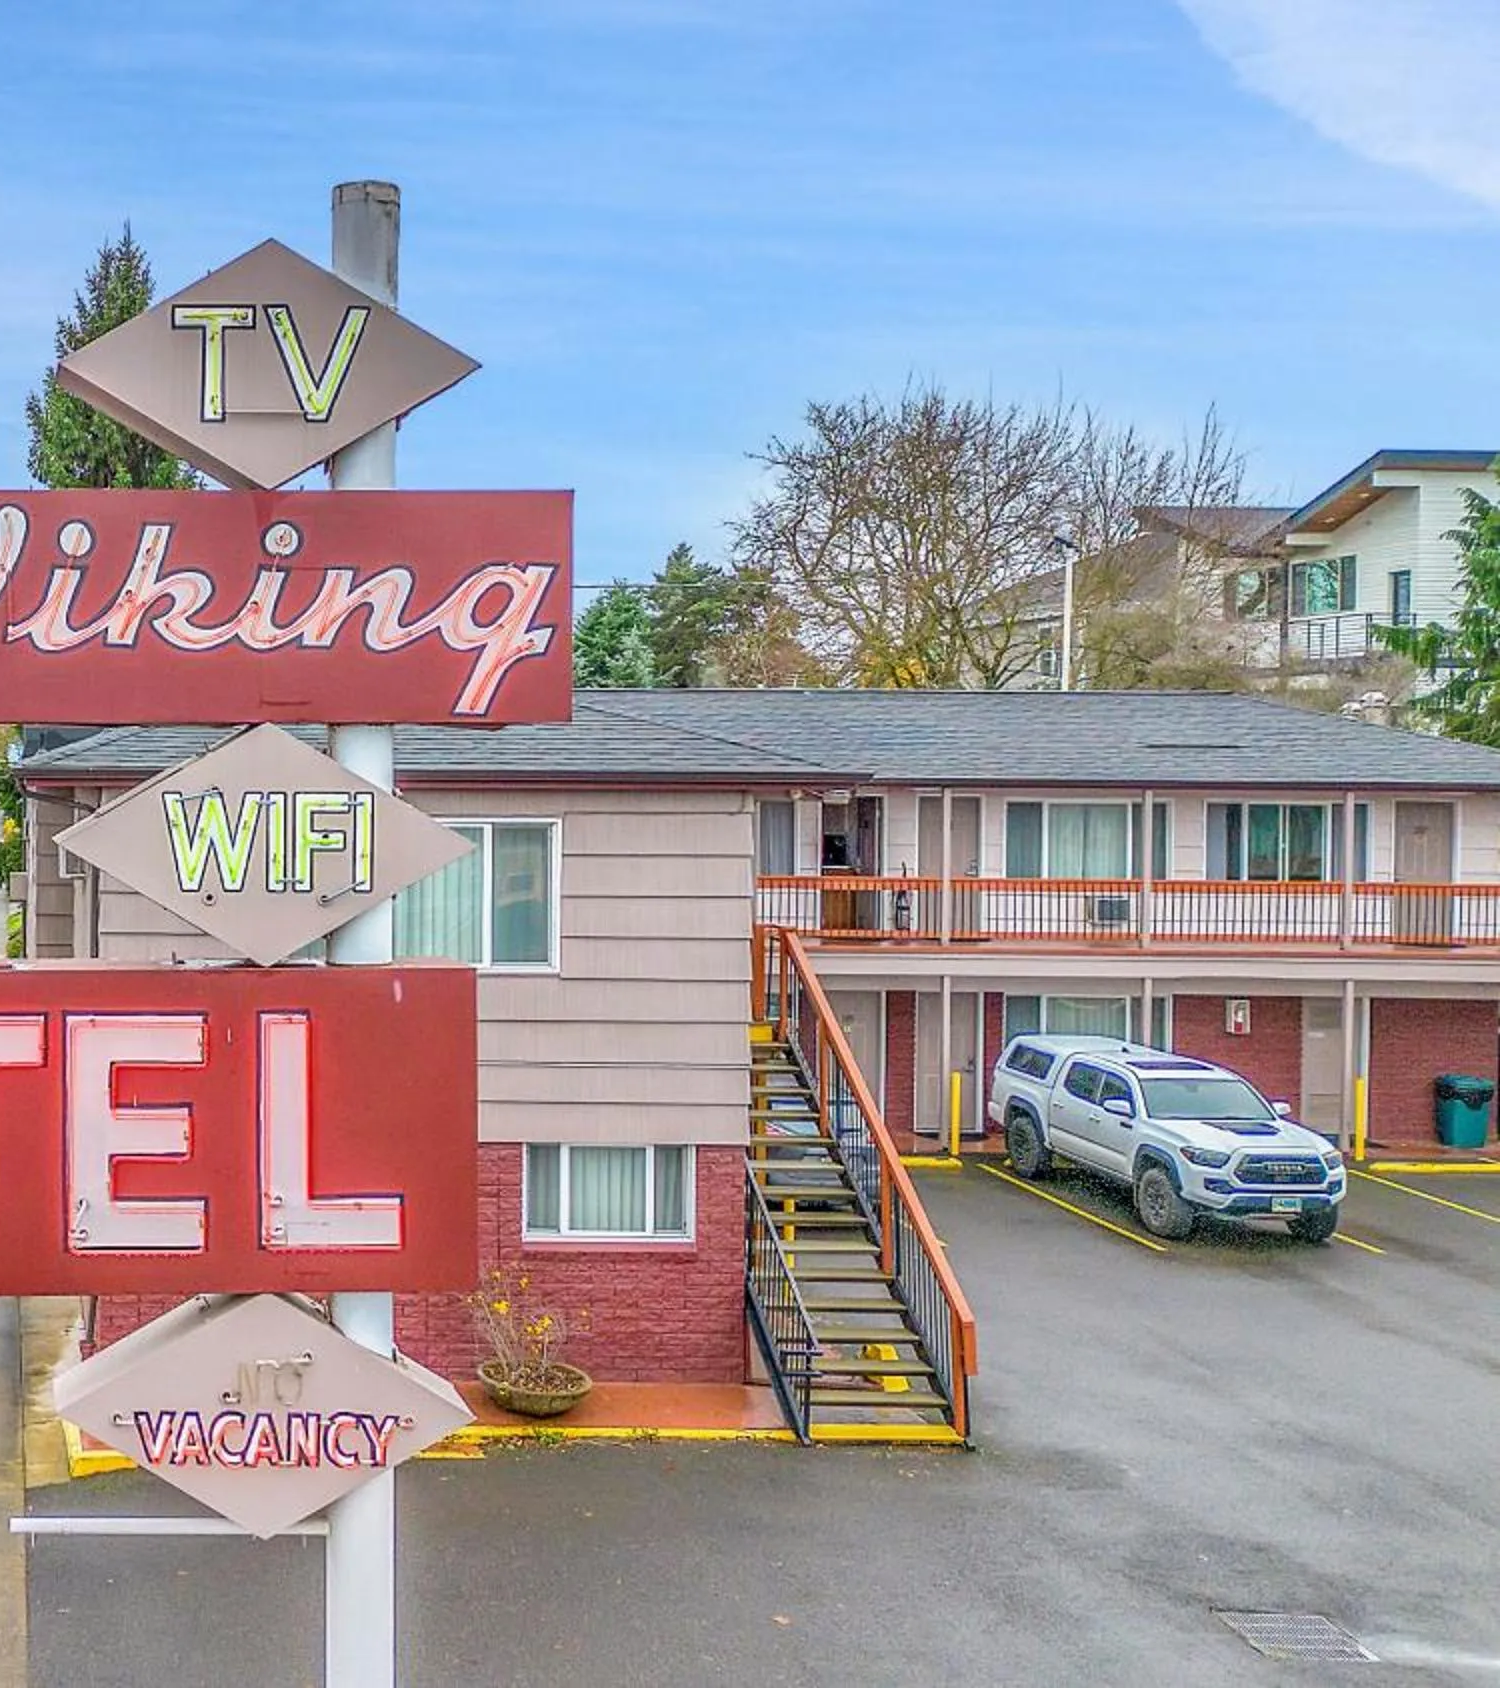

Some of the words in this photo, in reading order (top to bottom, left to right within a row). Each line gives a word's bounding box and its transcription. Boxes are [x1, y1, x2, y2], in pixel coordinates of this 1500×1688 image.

[171, 304, 370, 423] TV
[162, 791, 374, 893] WIFI
[133, 1410, 400, 1468] VACANCY
